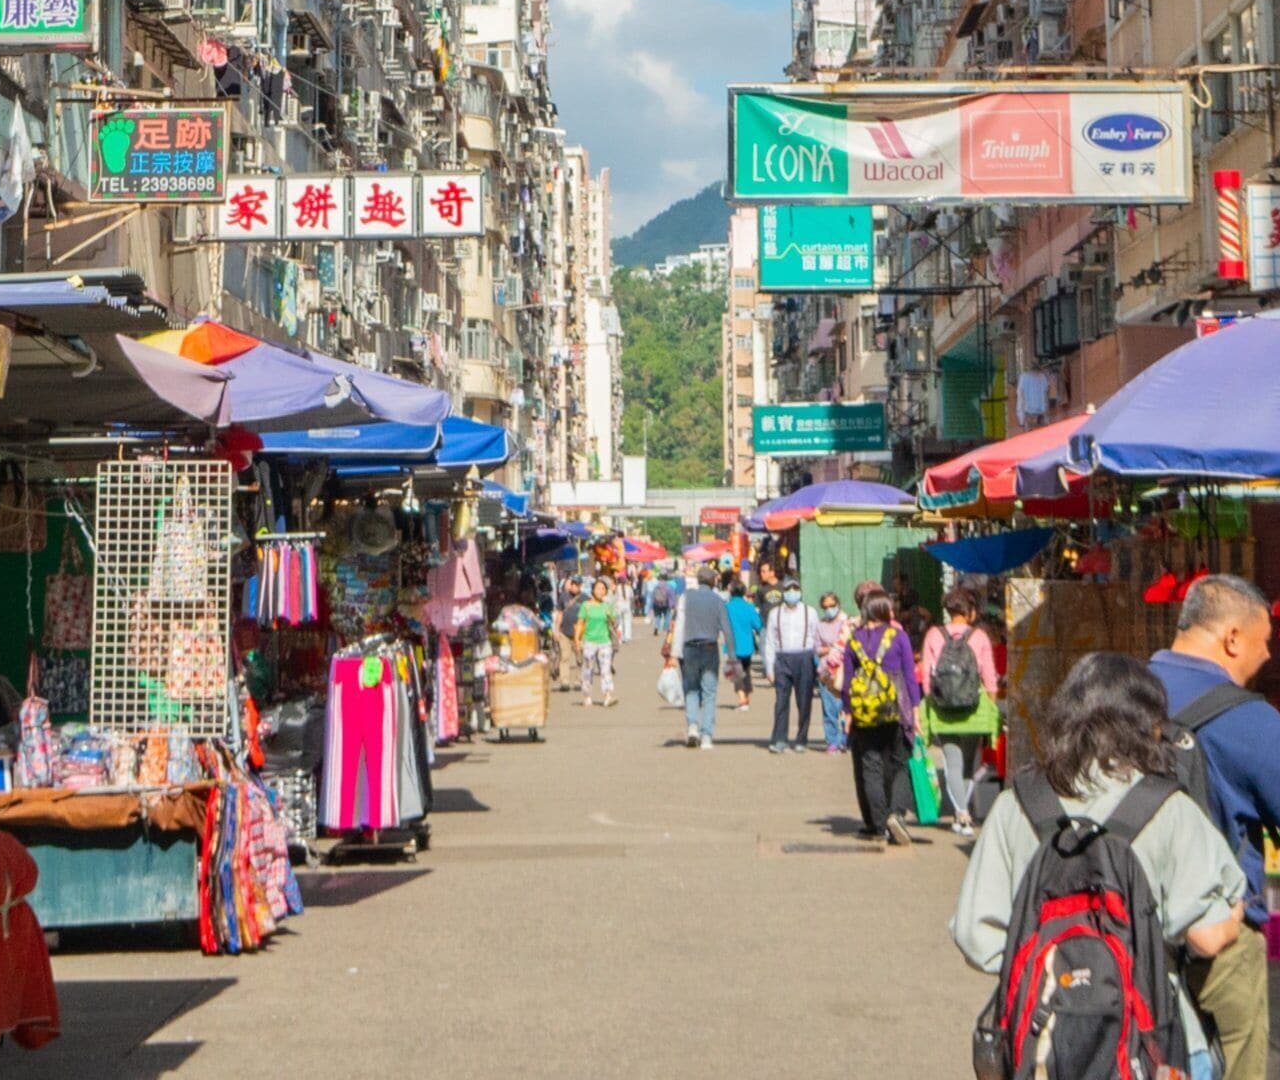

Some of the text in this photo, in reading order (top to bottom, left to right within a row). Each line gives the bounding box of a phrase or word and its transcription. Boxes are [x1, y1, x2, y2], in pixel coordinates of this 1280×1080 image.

[134, 118, 211, 149] 足跡
[1091, 127, 1164, 142] Embry Form
[981, 139, 1051, 162] Triumph
[130, 150, 215, 174] 正宗按摩
[752, 143, 835, 183] LEONA
[863, 162, 944, 182] Wacoal
[1099, 161, 1157, 176] 安莉芳
[141, 177, 215, 192] 23938698
